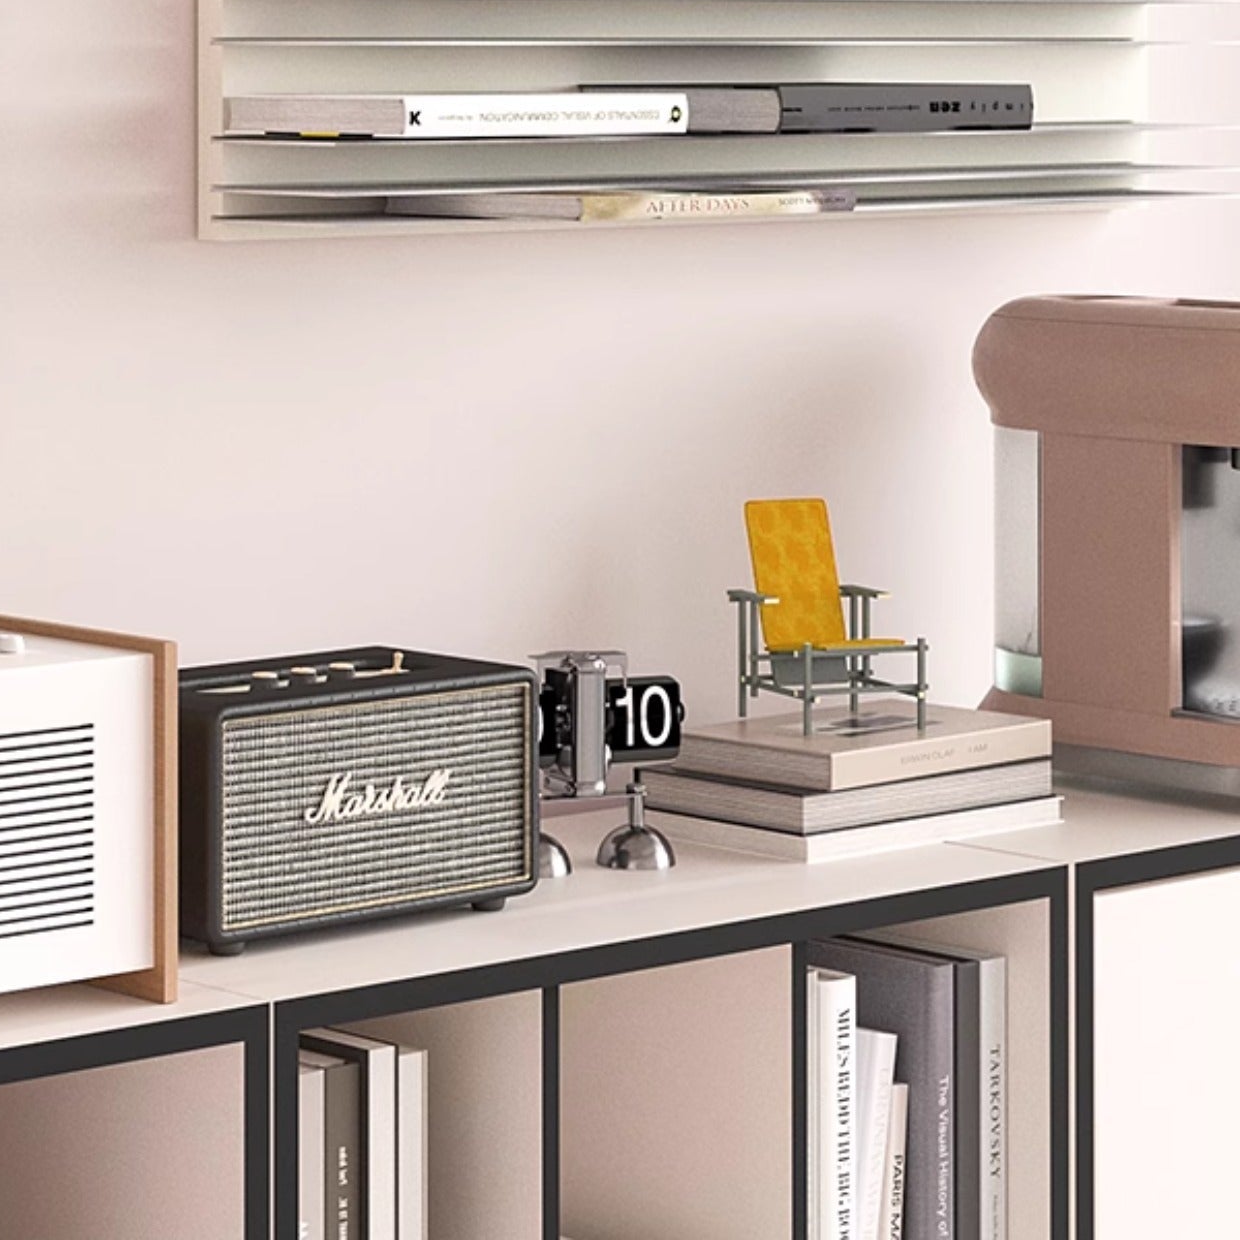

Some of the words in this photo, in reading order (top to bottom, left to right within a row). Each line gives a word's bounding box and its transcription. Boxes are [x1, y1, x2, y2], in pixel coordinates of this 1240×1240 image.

[409, 110, 422, 126] K
[929, 100, 961, 114] zen
[646, 199, 702, 214] AFTER
[705, 198, 750, 211] DAYS
[615, 685, 671, 748] 10
[304, 769, 452, 825] Marshall
[836, 1008, 851, 1067] MILES
[836, 1071, 851, 1125] REDD
[938, 1075, 949, 1106] The
[989, 1044, 1002, 1179] TARKOVSKY
[836, 1127, 851, 1170] THE
[938, 1109, 949, 1157] Visual
[837, 1172, 851, 1206] BIG
[891, 1154, 904, 1207] PARIS
[936, 1160, 950, 1217] History
[938, 1221, 950, 1236] of
